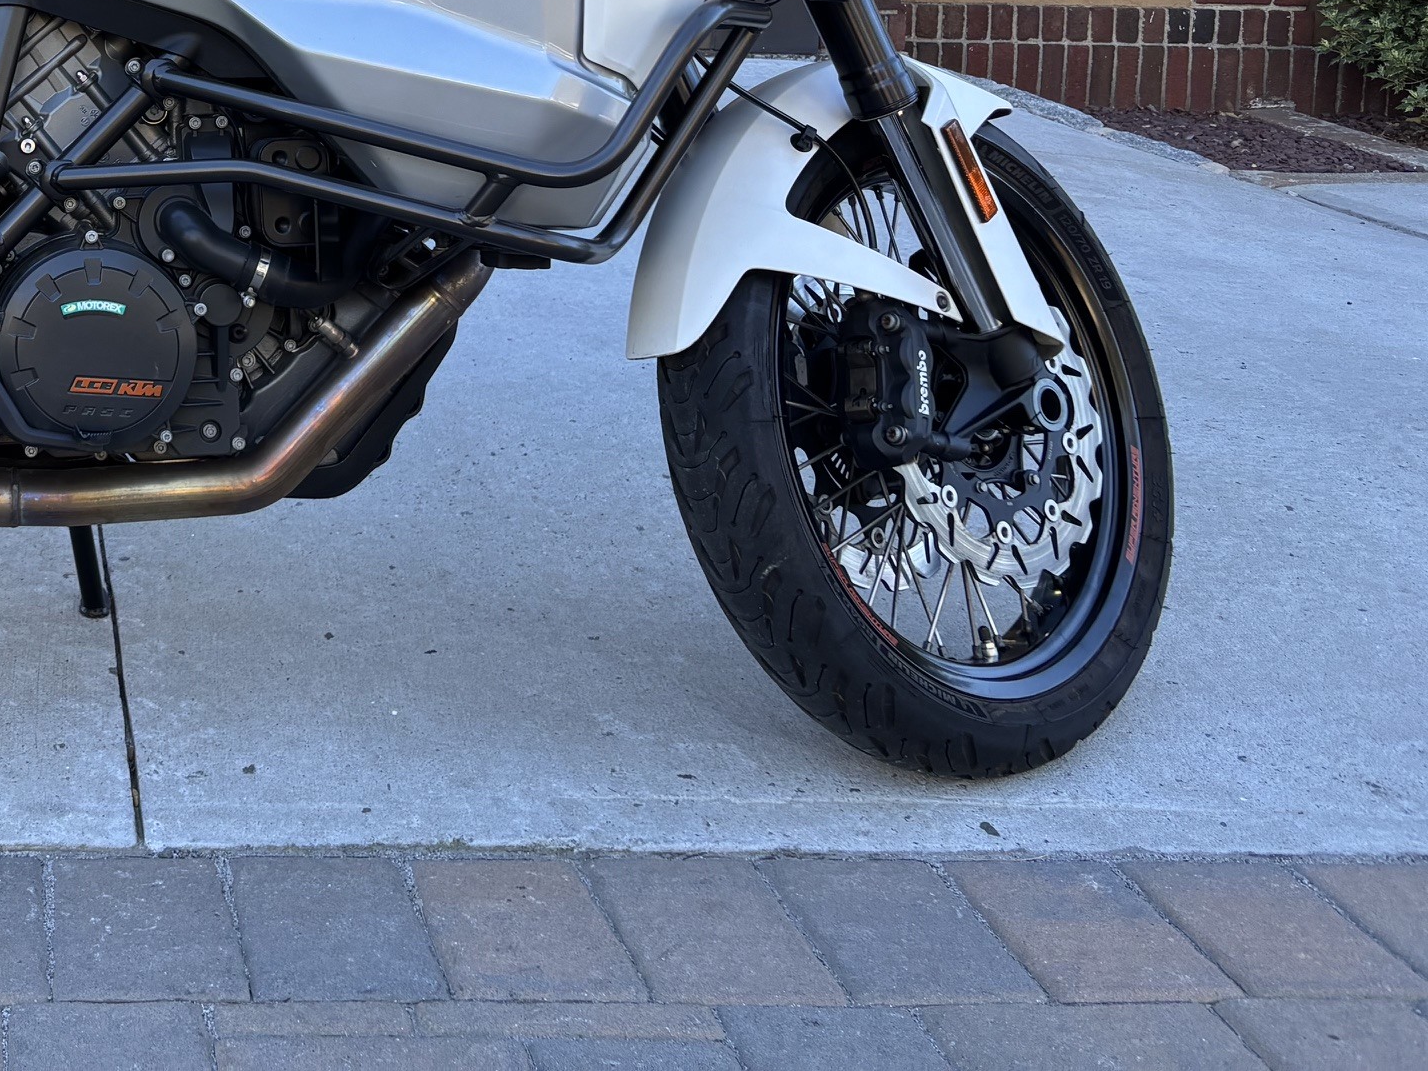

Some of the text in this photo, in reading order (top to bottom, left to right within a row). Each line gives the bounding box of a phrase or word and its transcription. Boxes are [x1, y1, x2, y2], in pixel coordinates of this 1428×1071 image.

[989, 150, 1053, 204] MICHELIN
[1058, 213, 1113, 290] 120/70 ZR 19
[77, 300, 122, 313] MOTOREX
[117, 379, 163, 397] KTM
[916, 349, 930, 417] brembo
